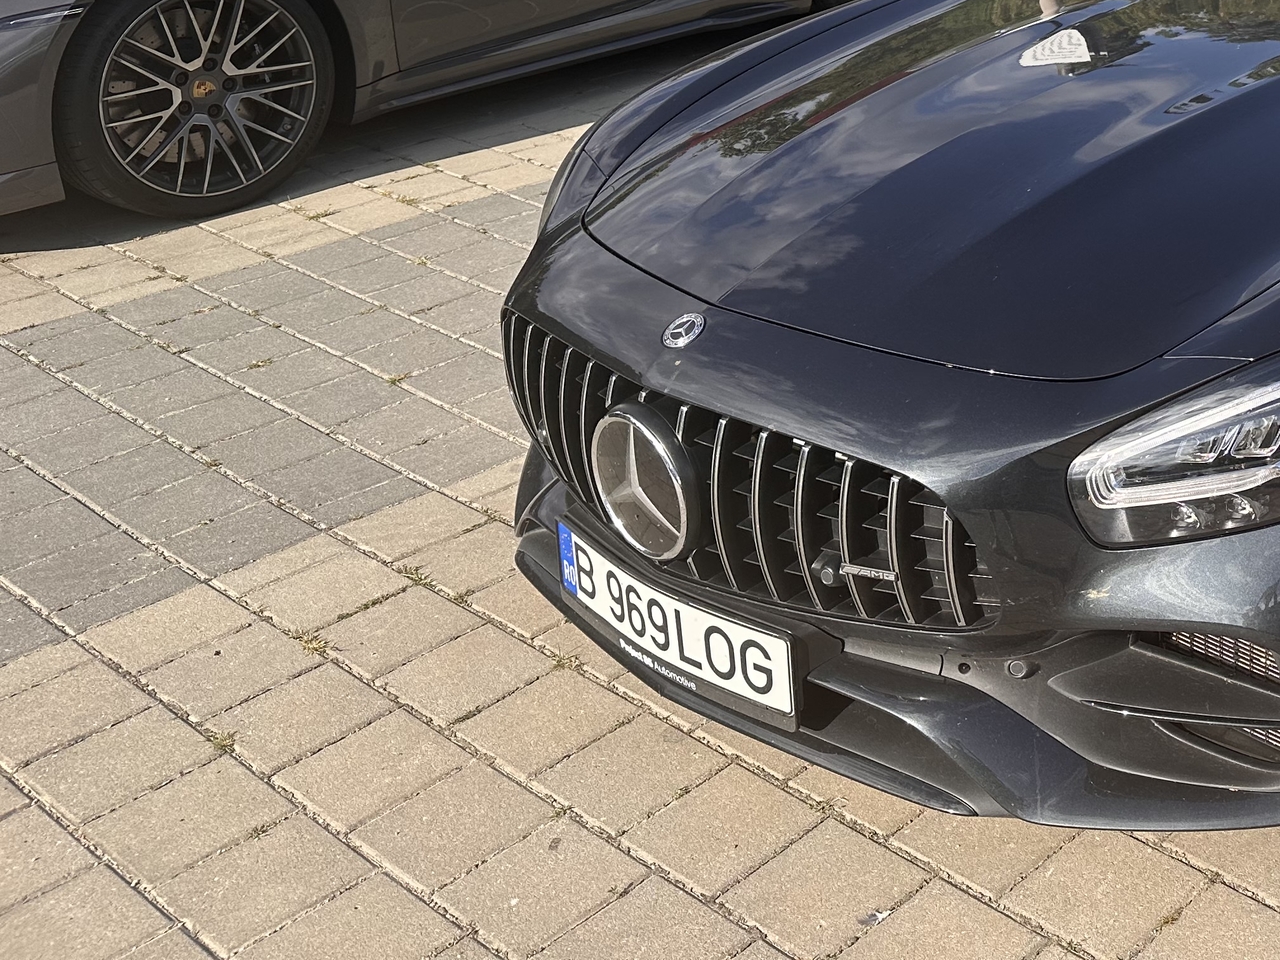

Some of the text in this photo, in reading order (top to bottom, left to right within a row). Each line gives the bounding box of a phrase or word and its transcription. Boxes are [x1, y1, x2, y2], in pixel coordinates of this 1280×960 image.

[563, 560, 576, 586] RO
[575, 541, 596, 600] B
[859, 570, 895, 581] AMG
[655, 661, 697, 691] Automotive
